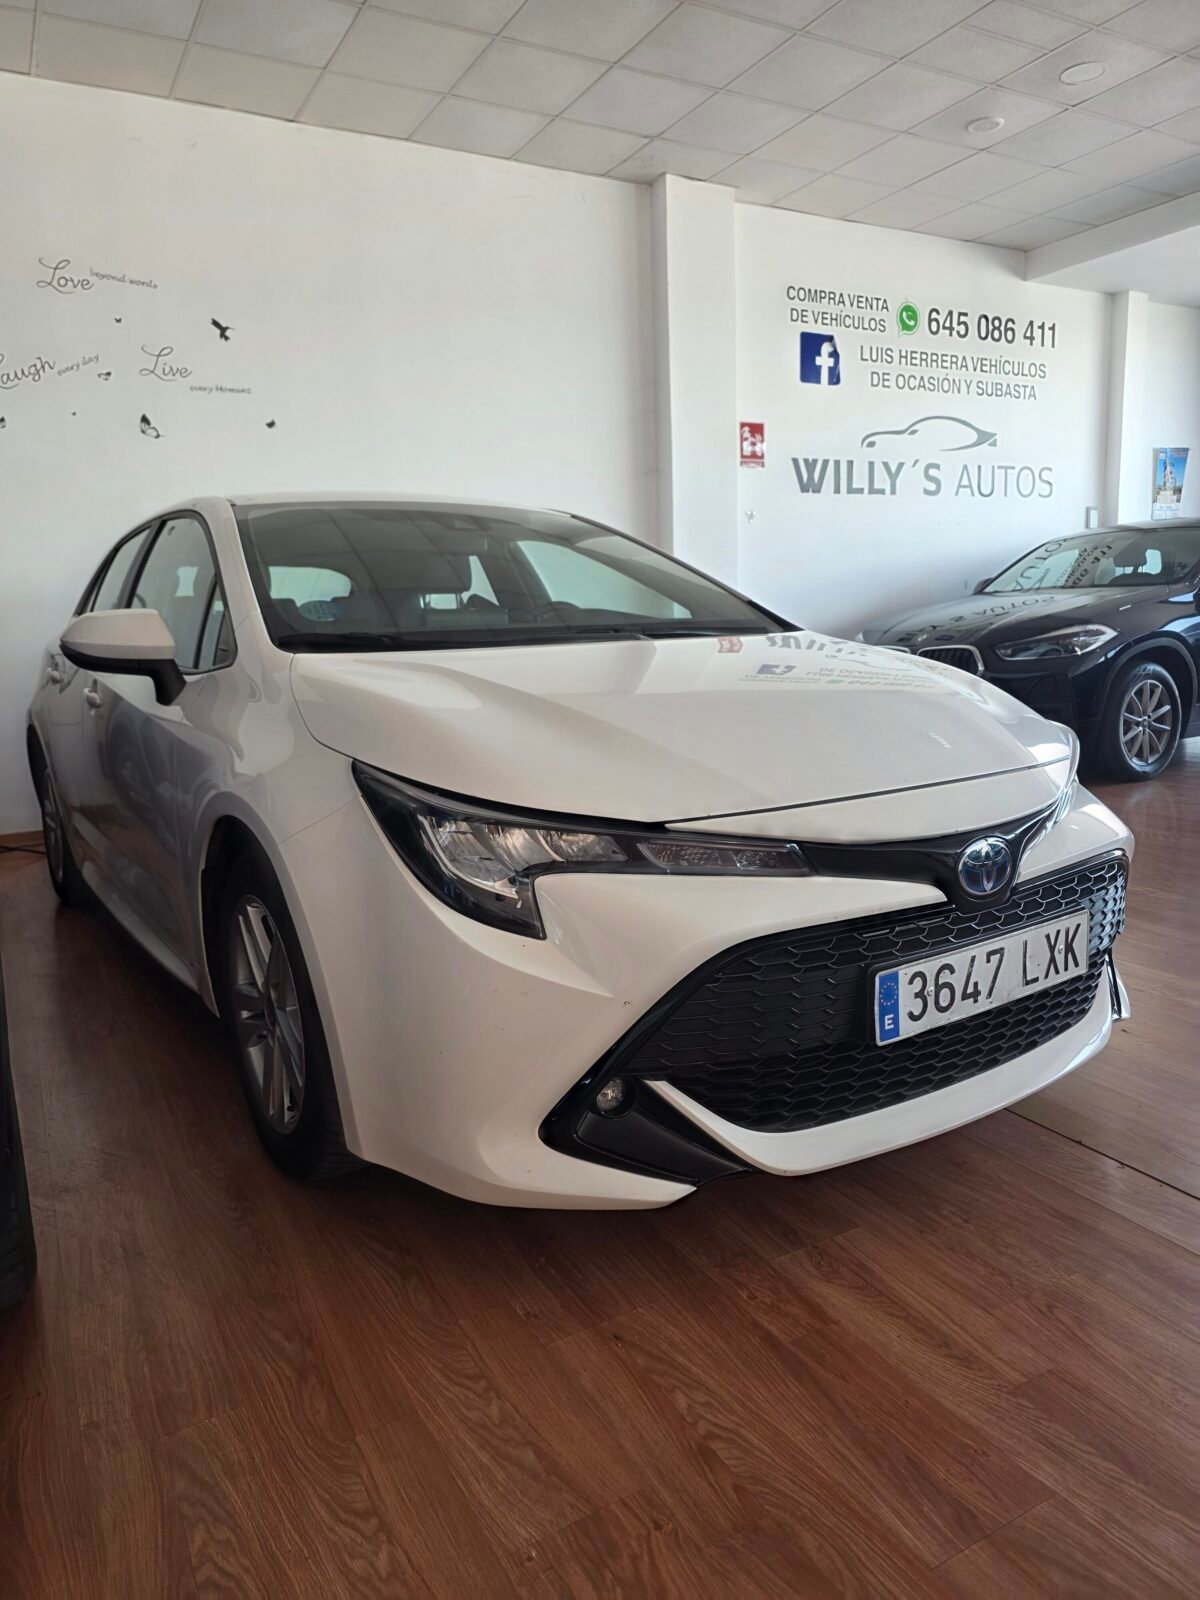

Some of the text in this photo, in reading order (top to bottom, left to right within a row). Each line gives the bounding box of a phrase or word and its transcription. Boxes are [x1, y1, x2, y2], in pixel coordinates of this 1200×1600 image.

[36, 257, 94, 294] Love
[90, 267, 158, 289] beyond words
[786, 285, 890, 312] COMPRA VENTA
[790, 308, 886, 333] DE VEHÍCULOS
[927, 307, 1056, 348] 645 086 411
[57, 354, 99, 376] every day
[138, 344, 192, 381] Live
[860, 345, 1047, 378] LUIS HERRERA VEHÍCULOS
[870, 371, 1037, 400] DE OCASIÓN Y SUBASTA
[955, 463, 1053, 498] AUTOS
[907, 923, 1081, 1022] 3647 LXK
[884, 1014, 895, 1030] E
